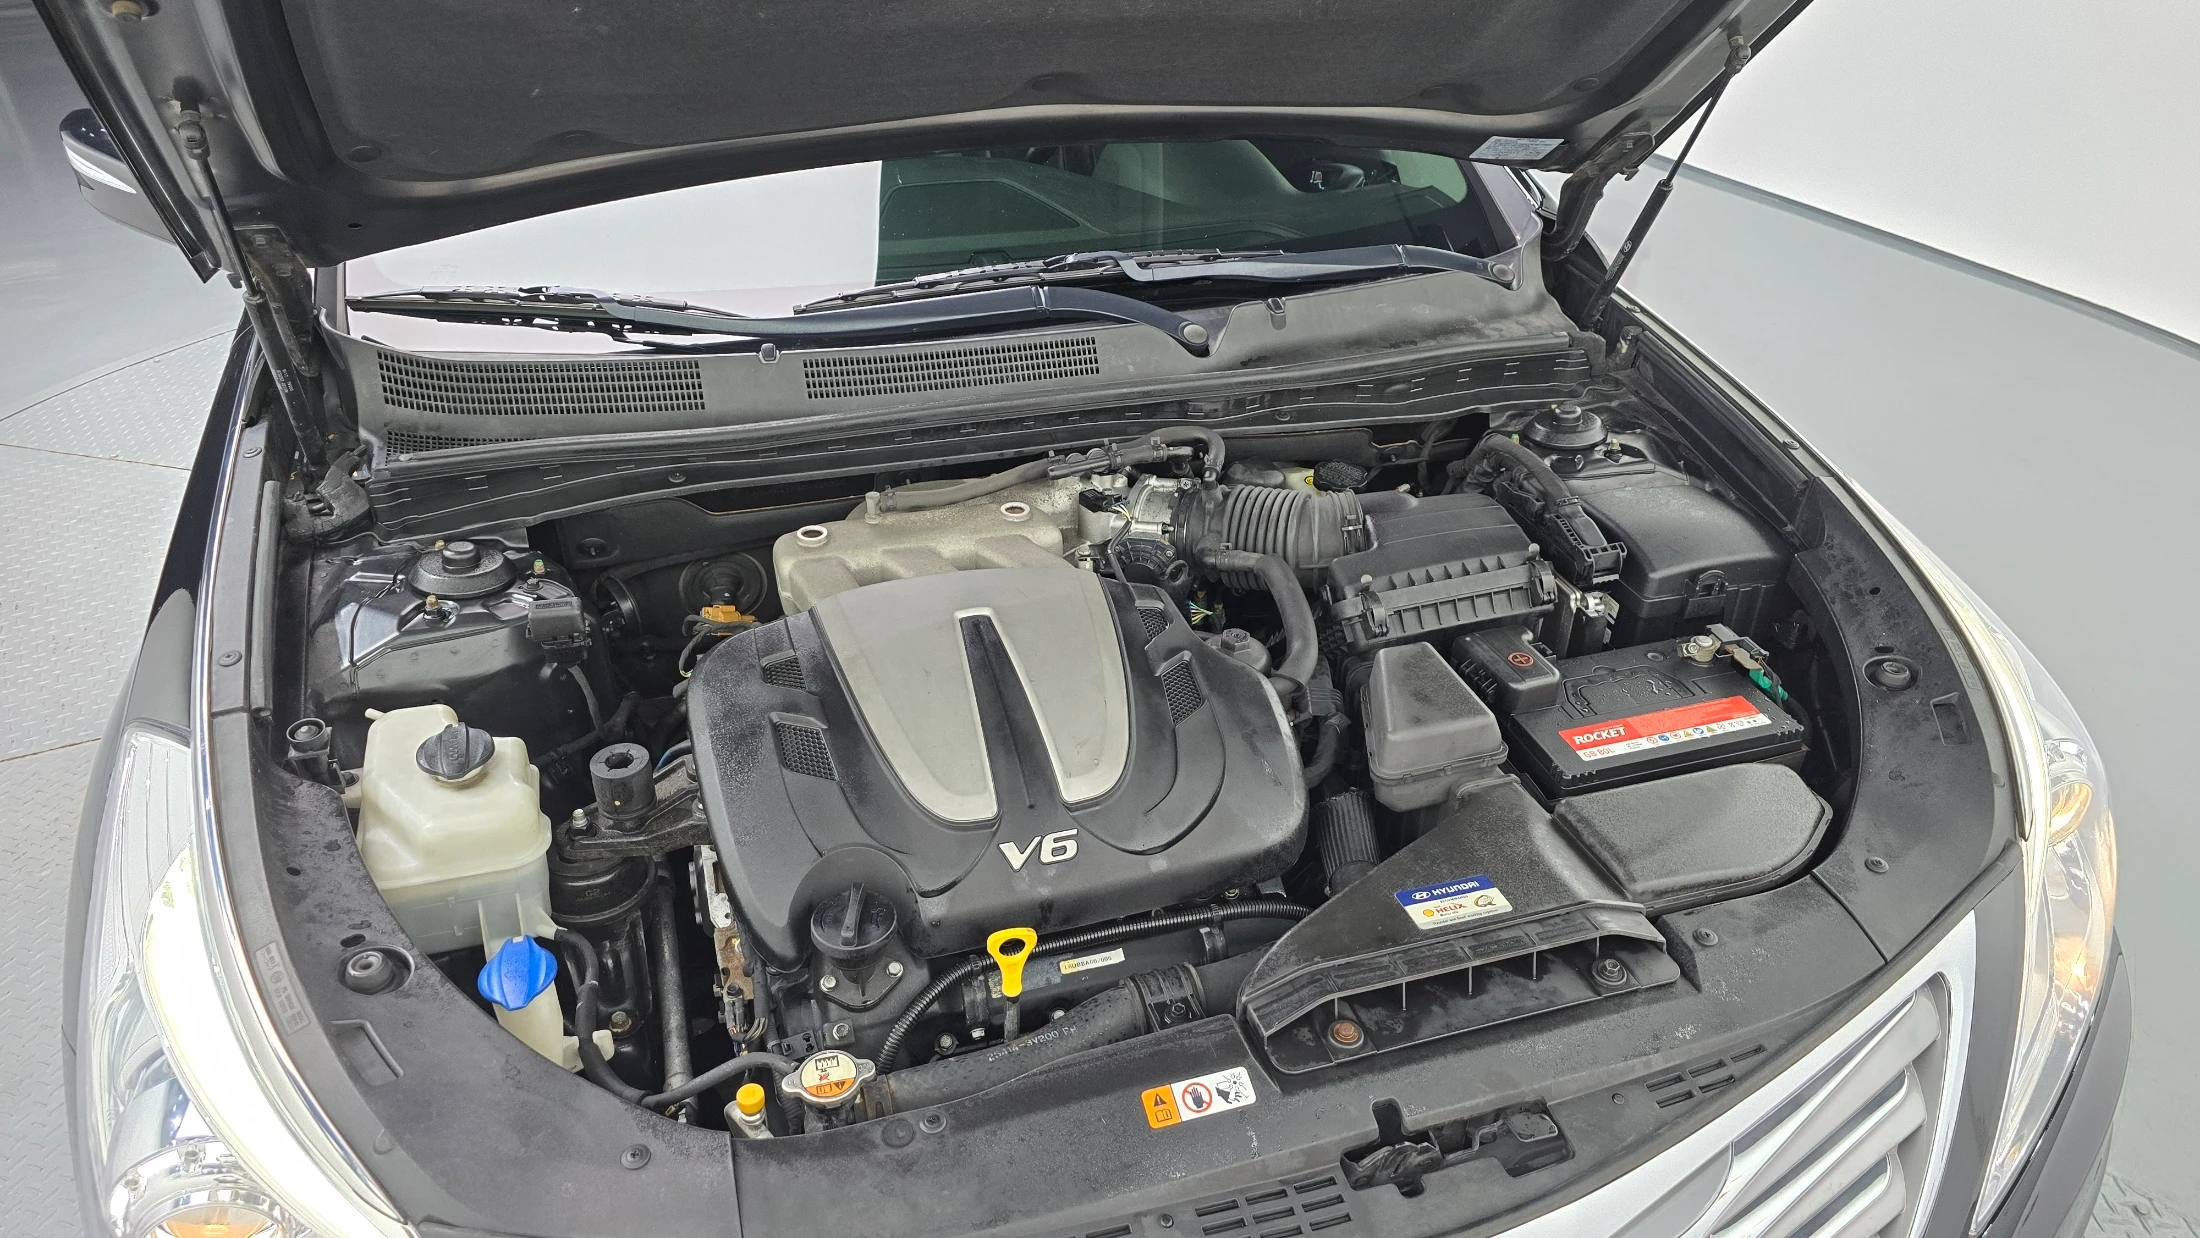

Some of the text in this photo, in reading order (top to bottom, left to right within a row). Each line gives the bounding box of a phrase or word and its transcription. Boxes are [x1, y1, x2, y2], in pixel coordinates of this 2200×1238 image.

[1572, 726, 1626, 744] ROCKET
[1583, 750, 1597, 758] GB
[999, 828, 1078, 870] V6
[1431, 880, 1480, 896] HYUNDAI
[1435, 903, 1467, 914] HELIX
